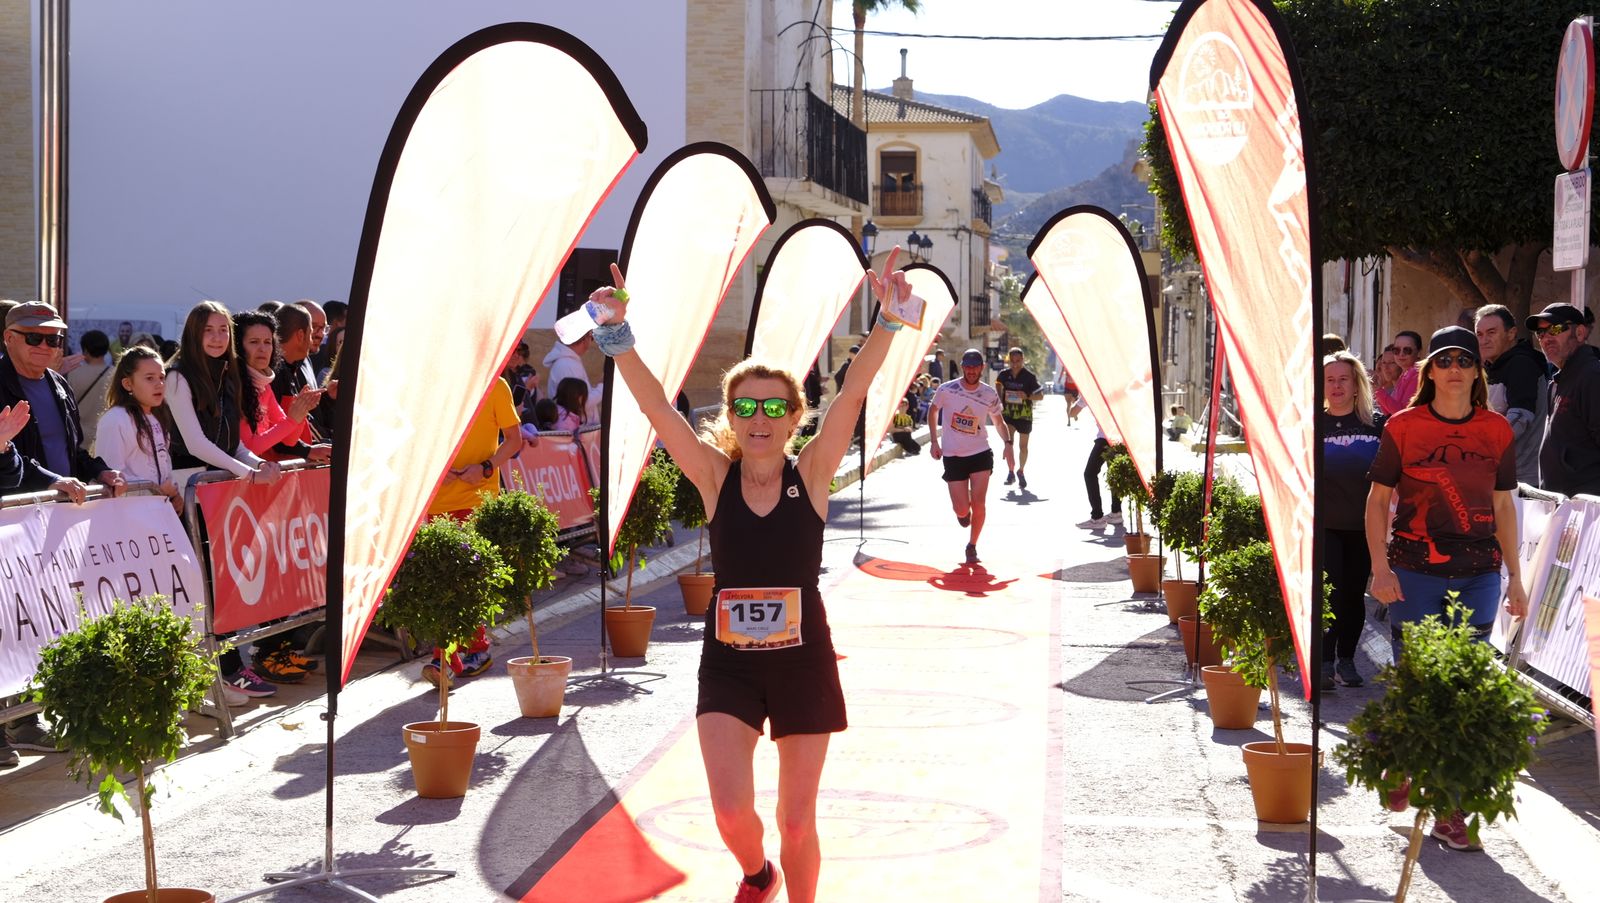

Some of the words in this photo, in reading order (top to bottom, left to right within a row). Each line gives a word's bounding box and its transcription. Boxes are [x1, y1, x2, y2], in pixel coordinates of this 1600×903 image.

[955, 416, 974, 427] 308
[1436, 471, 1450, 488] LA
[148, 534, 176, 556] DE
[0, 564, 190, 643] ANTORIA
[731, 603, 783, 623] 157
